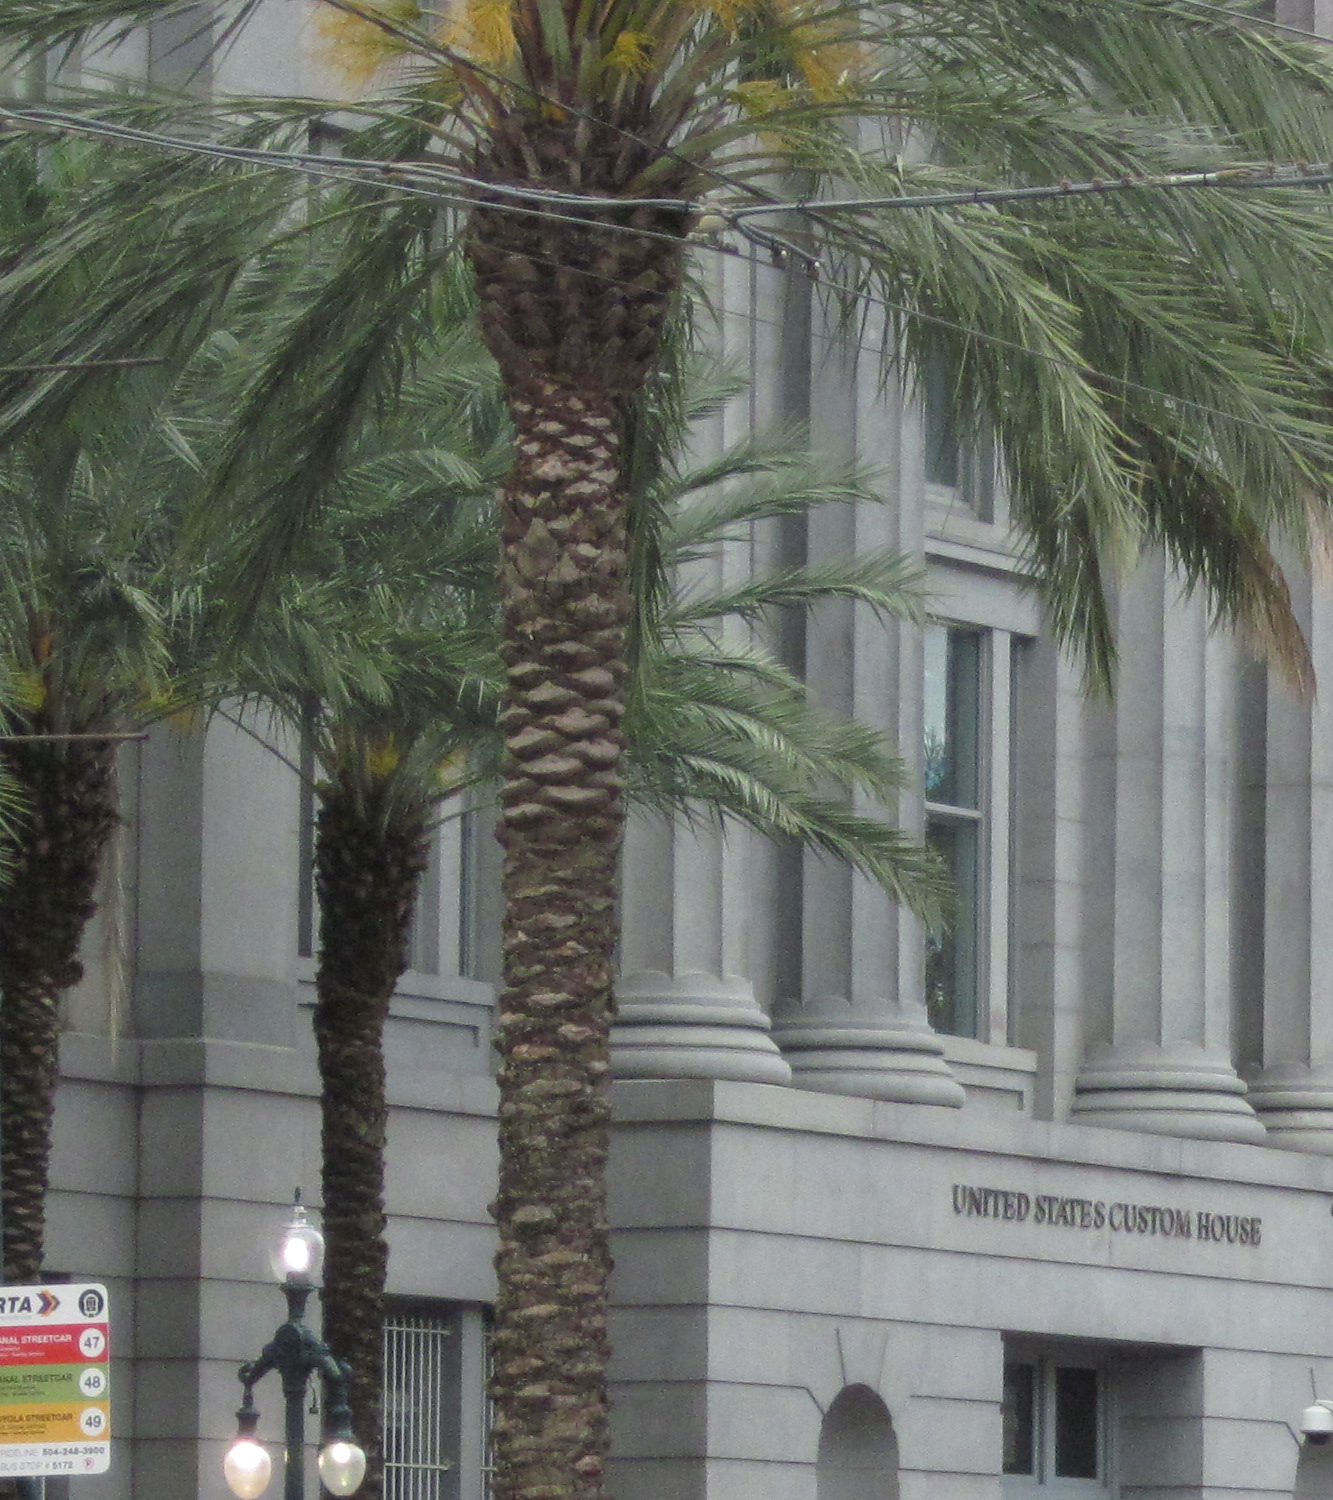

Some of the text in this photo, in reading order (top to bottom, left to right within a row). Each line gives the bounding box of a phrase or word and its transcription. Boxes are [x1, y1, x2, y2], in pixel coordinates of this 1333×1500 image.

[952, 1184, 1262, 1246] UNITED STATES CUSTOM HOUSE
[21, 1334, 72, 1344] STREETCAR
[83, 1336, 100, 1349] 47
[84, 1376, 101, 1389] 48
[85, 1415, 101, 1428] 49
